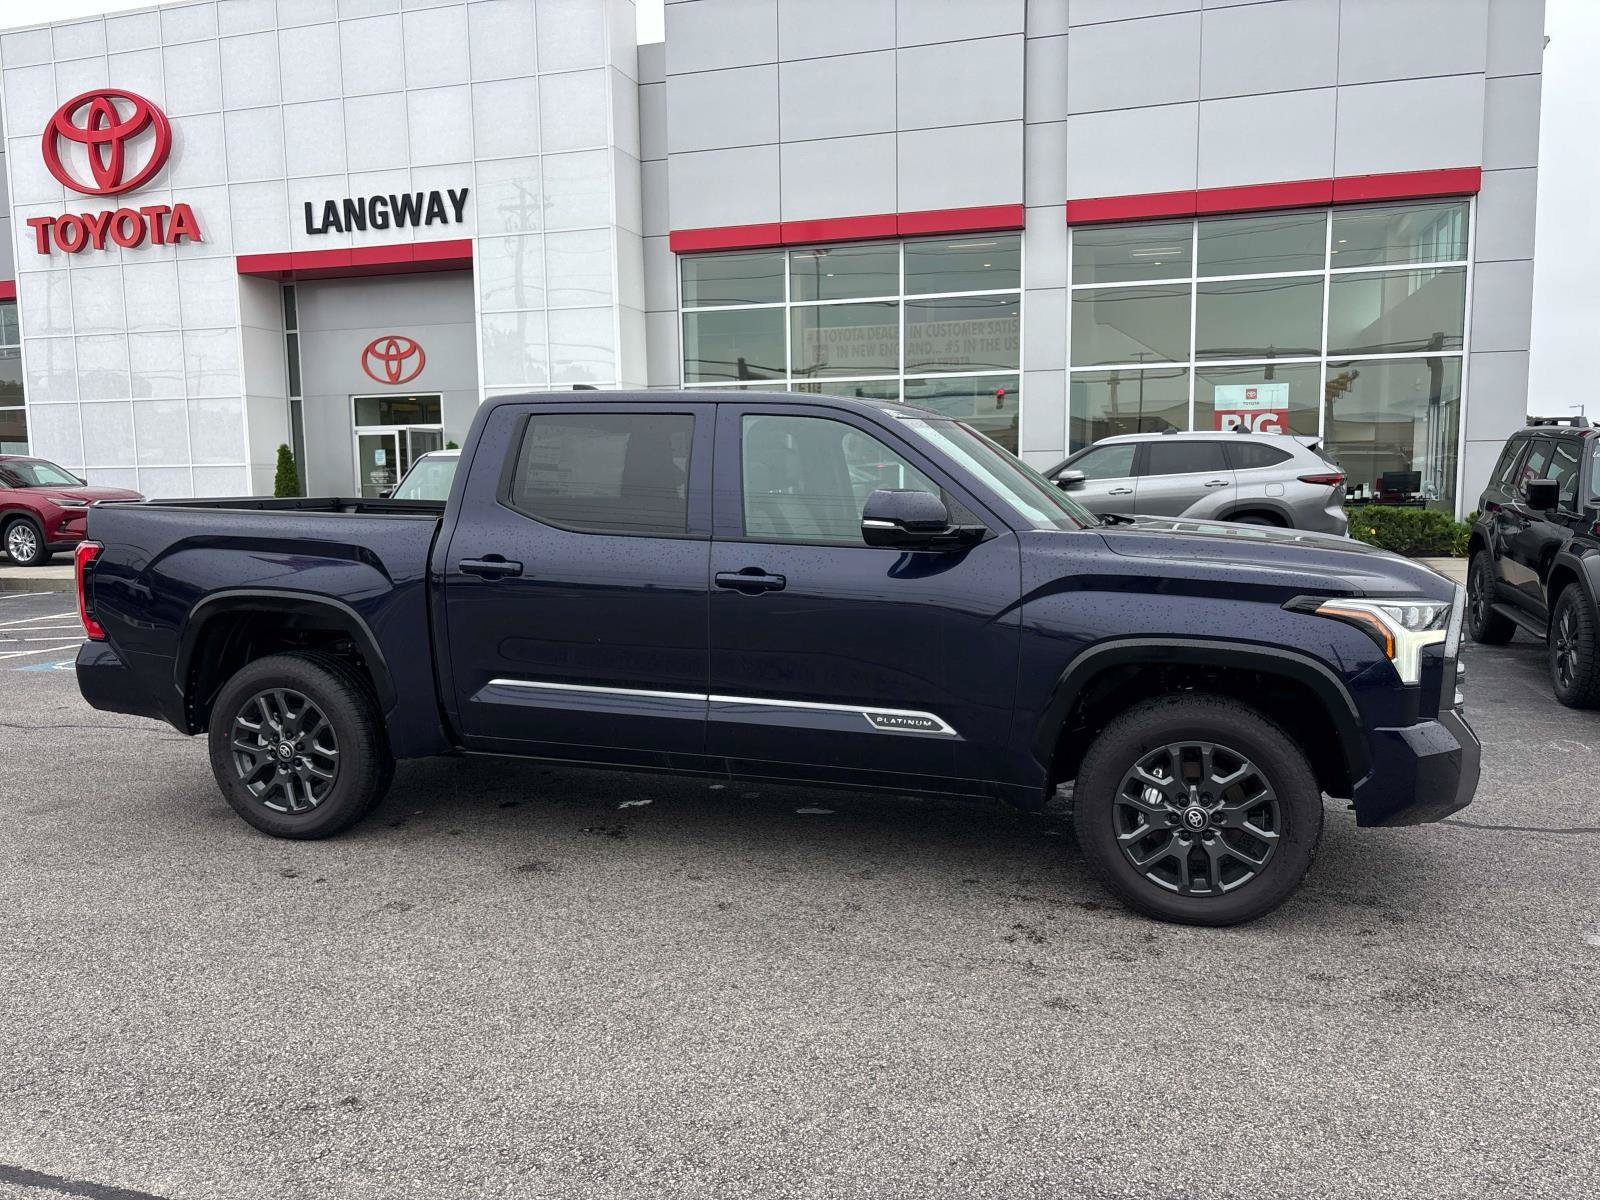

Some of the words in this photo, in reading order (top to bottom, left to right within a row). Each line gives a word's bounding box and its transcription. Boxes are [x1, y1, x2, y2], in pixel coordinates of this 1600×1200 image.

[304, 188, 469, 235] LANGWAY
[26, 203, 203, 255] TOYOTA
[823, 327, 865, 343] TOYOTA
[867, 325, 901, 340] DEALE
[909, 325, 922, 339] IN
[926, 321, 985, 337] CUSTOMER
[836, 344, 849, 359] IN
[851, 343, 876, 358] NEW
[945, 340, 960, 353] #5
[964, 338, 976, 353] IN
[980, 337, 1001, 352] THE
[876, 717, 932, 726] PLATINUM
